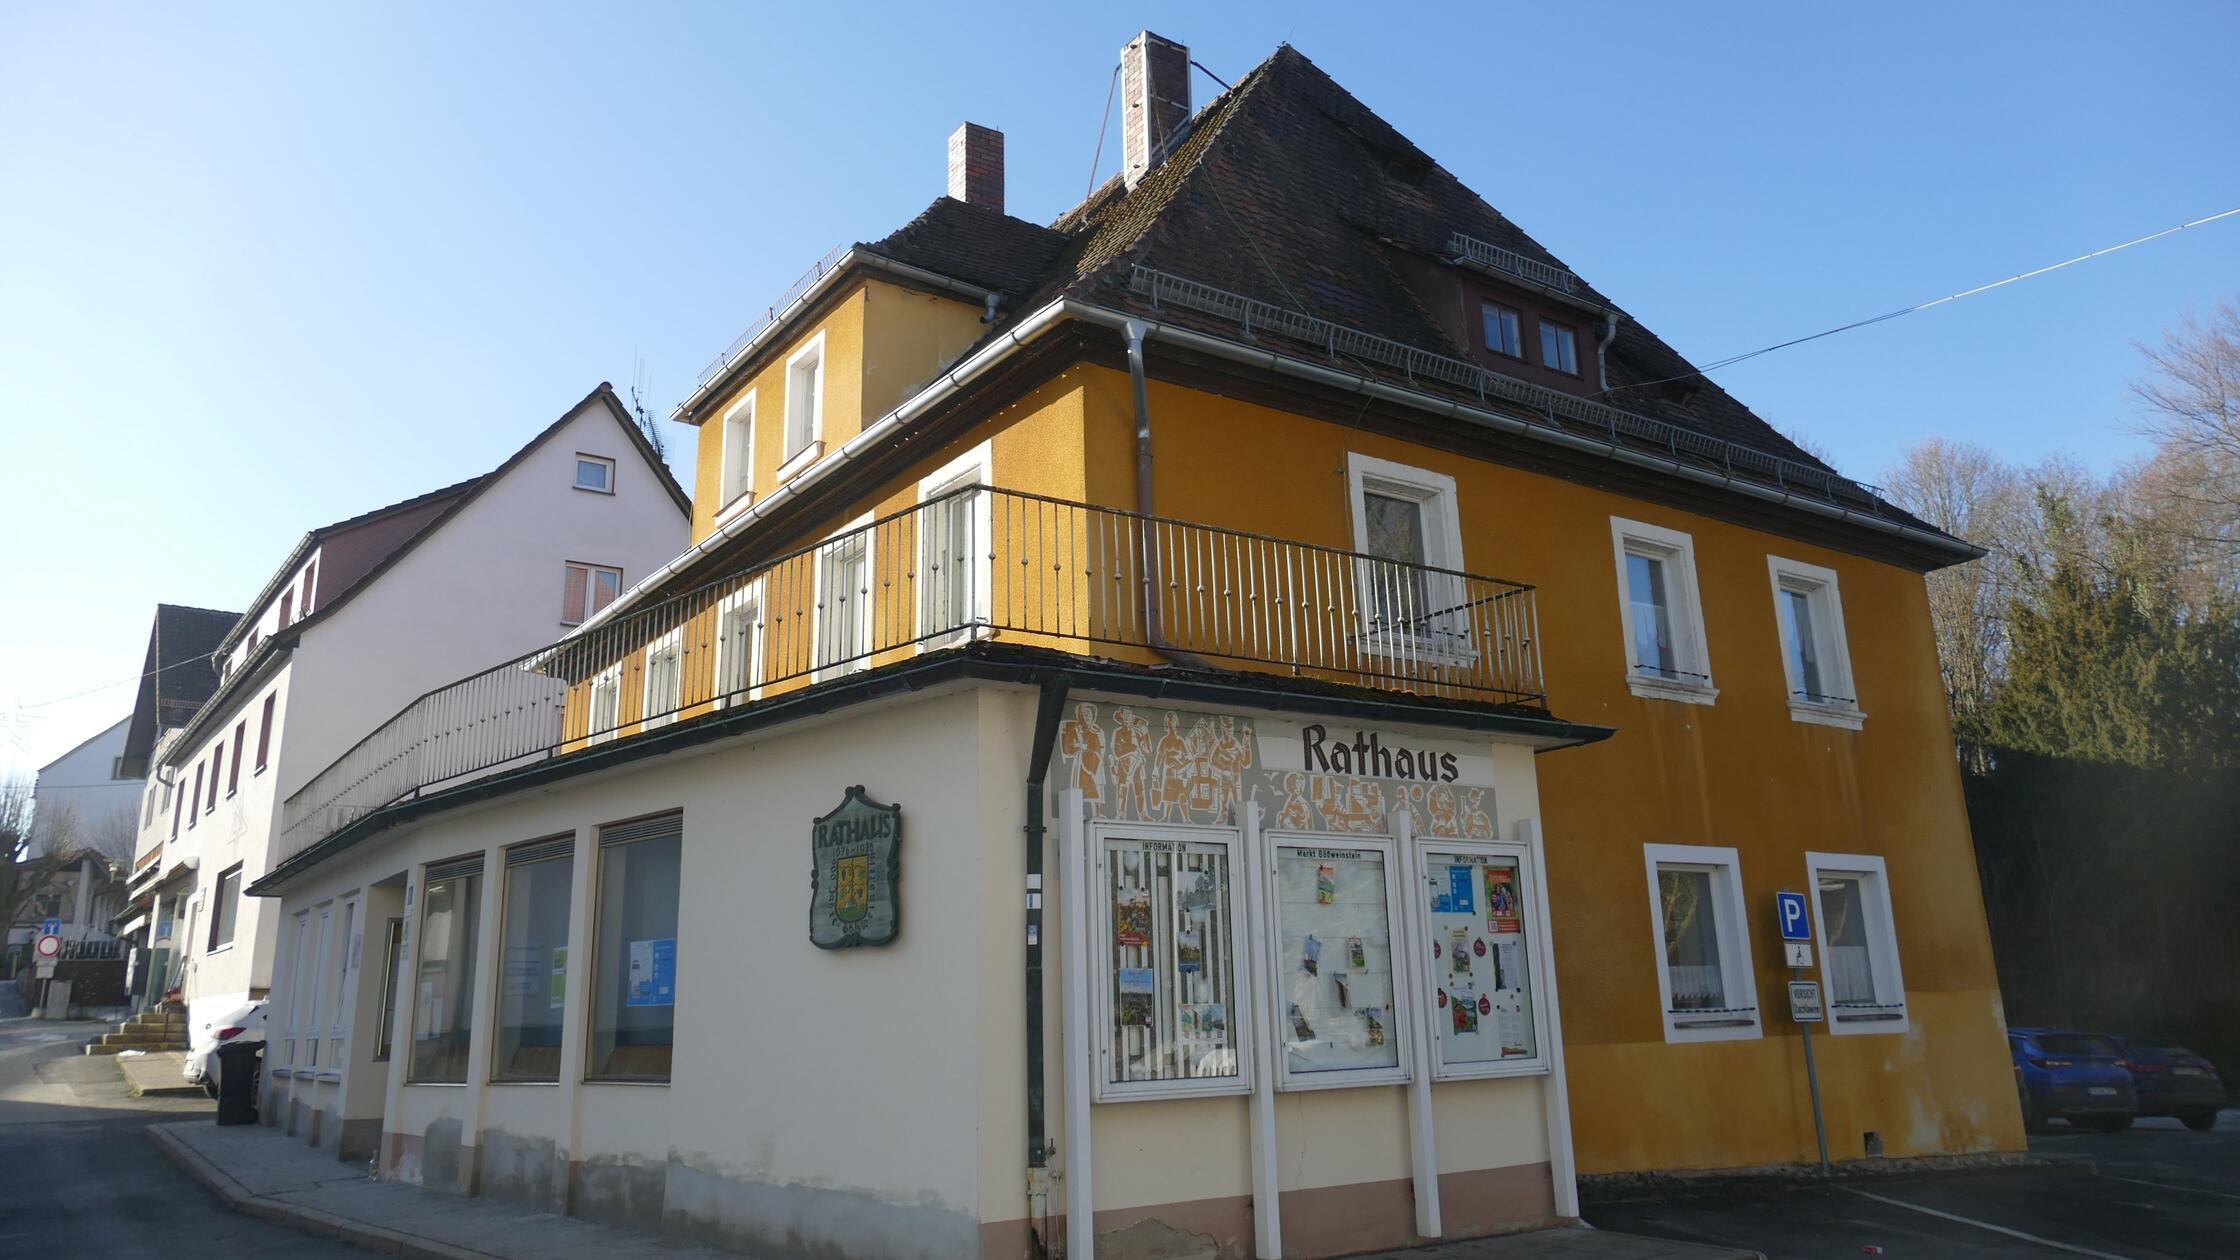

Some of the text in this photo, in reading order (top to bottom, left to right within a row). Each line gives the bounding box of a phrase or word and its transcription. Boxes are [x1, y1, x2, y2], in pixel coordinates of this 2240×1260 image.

[1302, 724, 1460, 784] Rathaus
[817, 813, 892, 849] RATHAUS
[1296, 849, 1316, 859] Markt
[1454, 855, 1488, 865] INFORMATION
[1784, 899, 1800, 933] P
